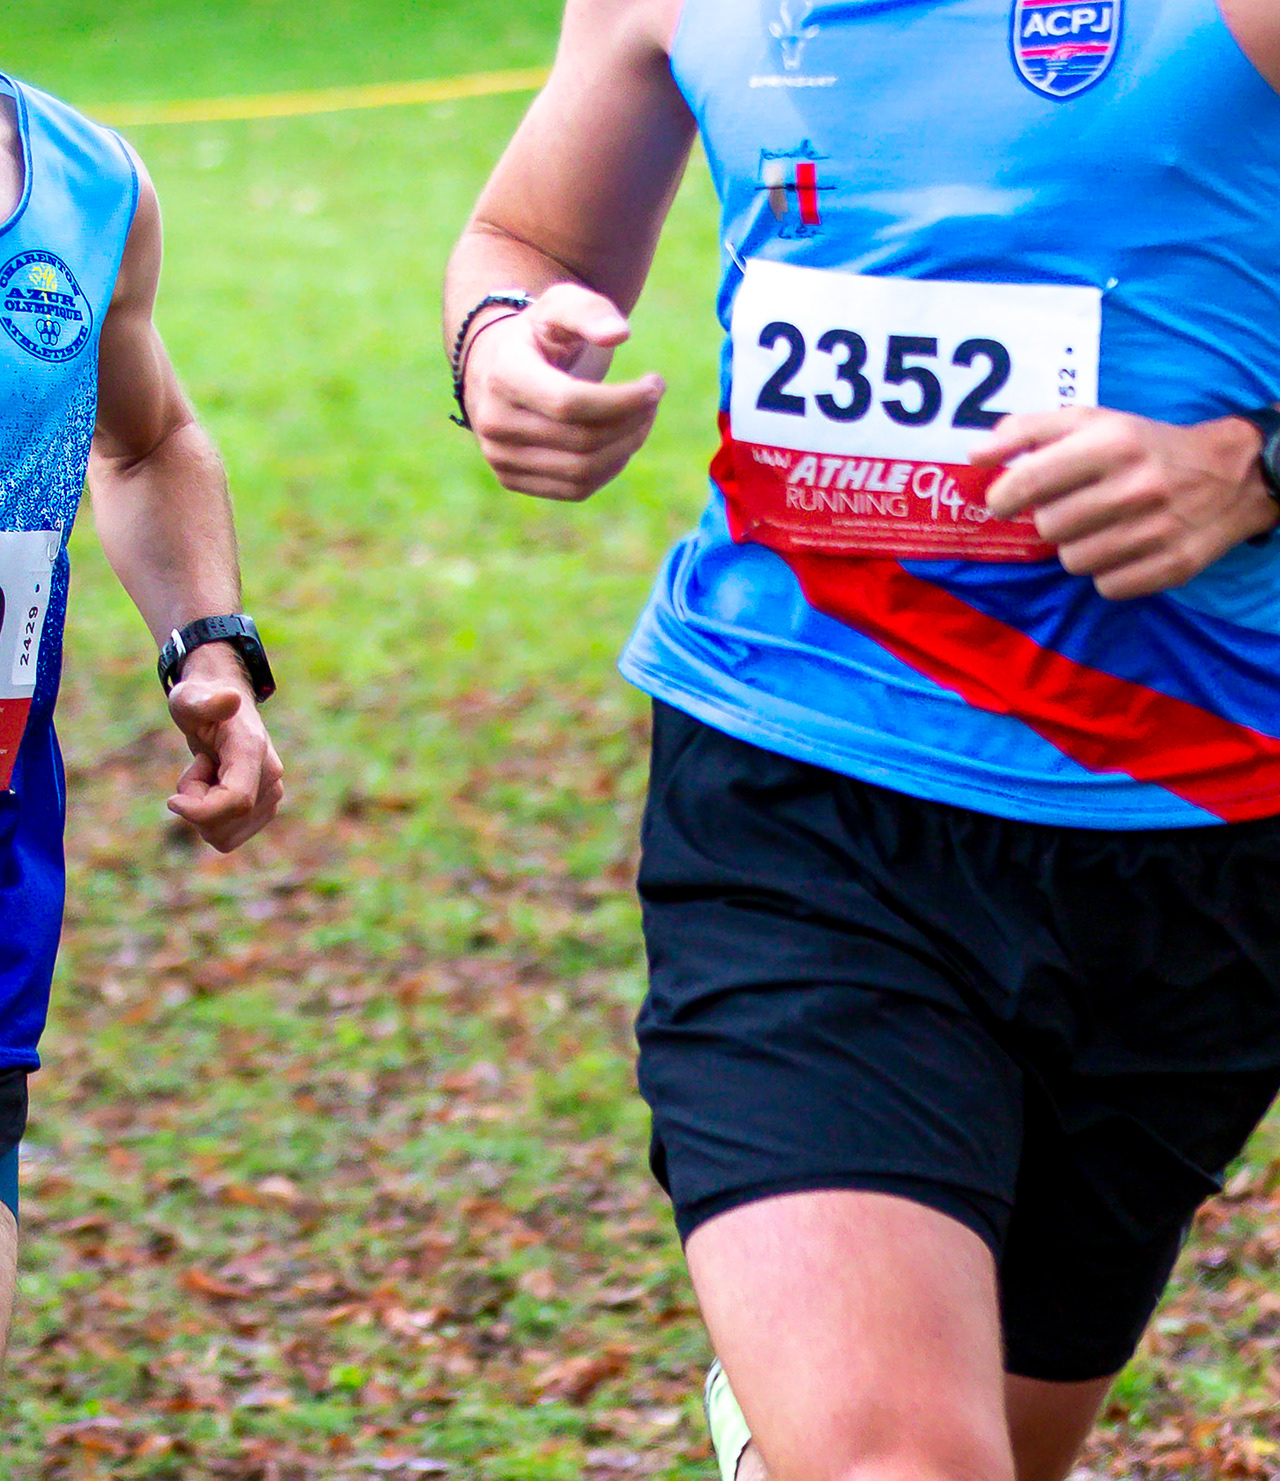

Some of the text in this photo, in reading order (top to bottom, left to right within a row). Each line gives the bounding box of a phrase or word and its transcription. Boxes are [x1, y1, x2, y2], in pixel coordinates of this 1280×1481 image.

[1023, 7, 1111, 38] ACPJ
[0, 253, 81, 296] CHARENTON
[4, 299, 83, 321] OLYMPIQUE
[6, 287, 76, 308] AZUR
[755, 321, 1011, 430] 2352
[787, 456, 914, 493] ATHLE
[786, 487, 908, 517] RUNNING
[20, 606, 38, 666] 2429
